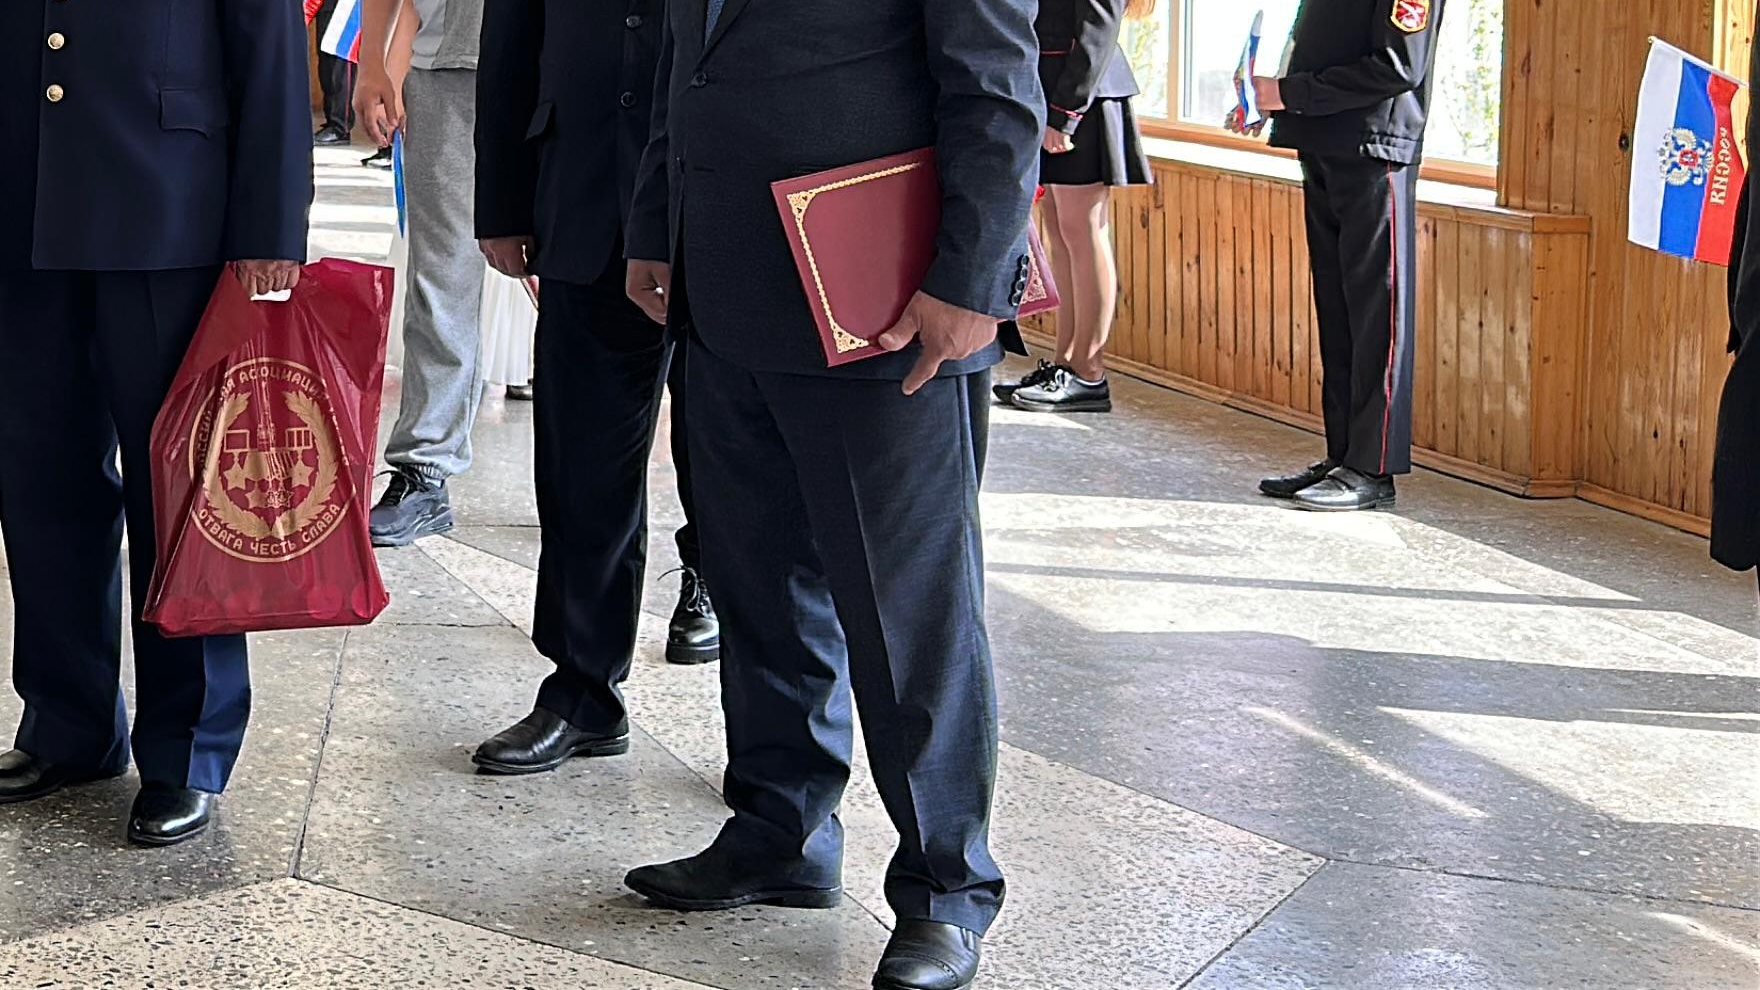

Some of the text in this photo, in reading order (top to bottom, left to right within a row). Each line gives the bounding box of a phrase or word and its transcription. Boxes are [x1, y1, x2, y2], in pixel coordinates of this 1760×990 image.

[198, 504, 341, 555] ОТВАГА ЧЕСТЬ СЛАВА
